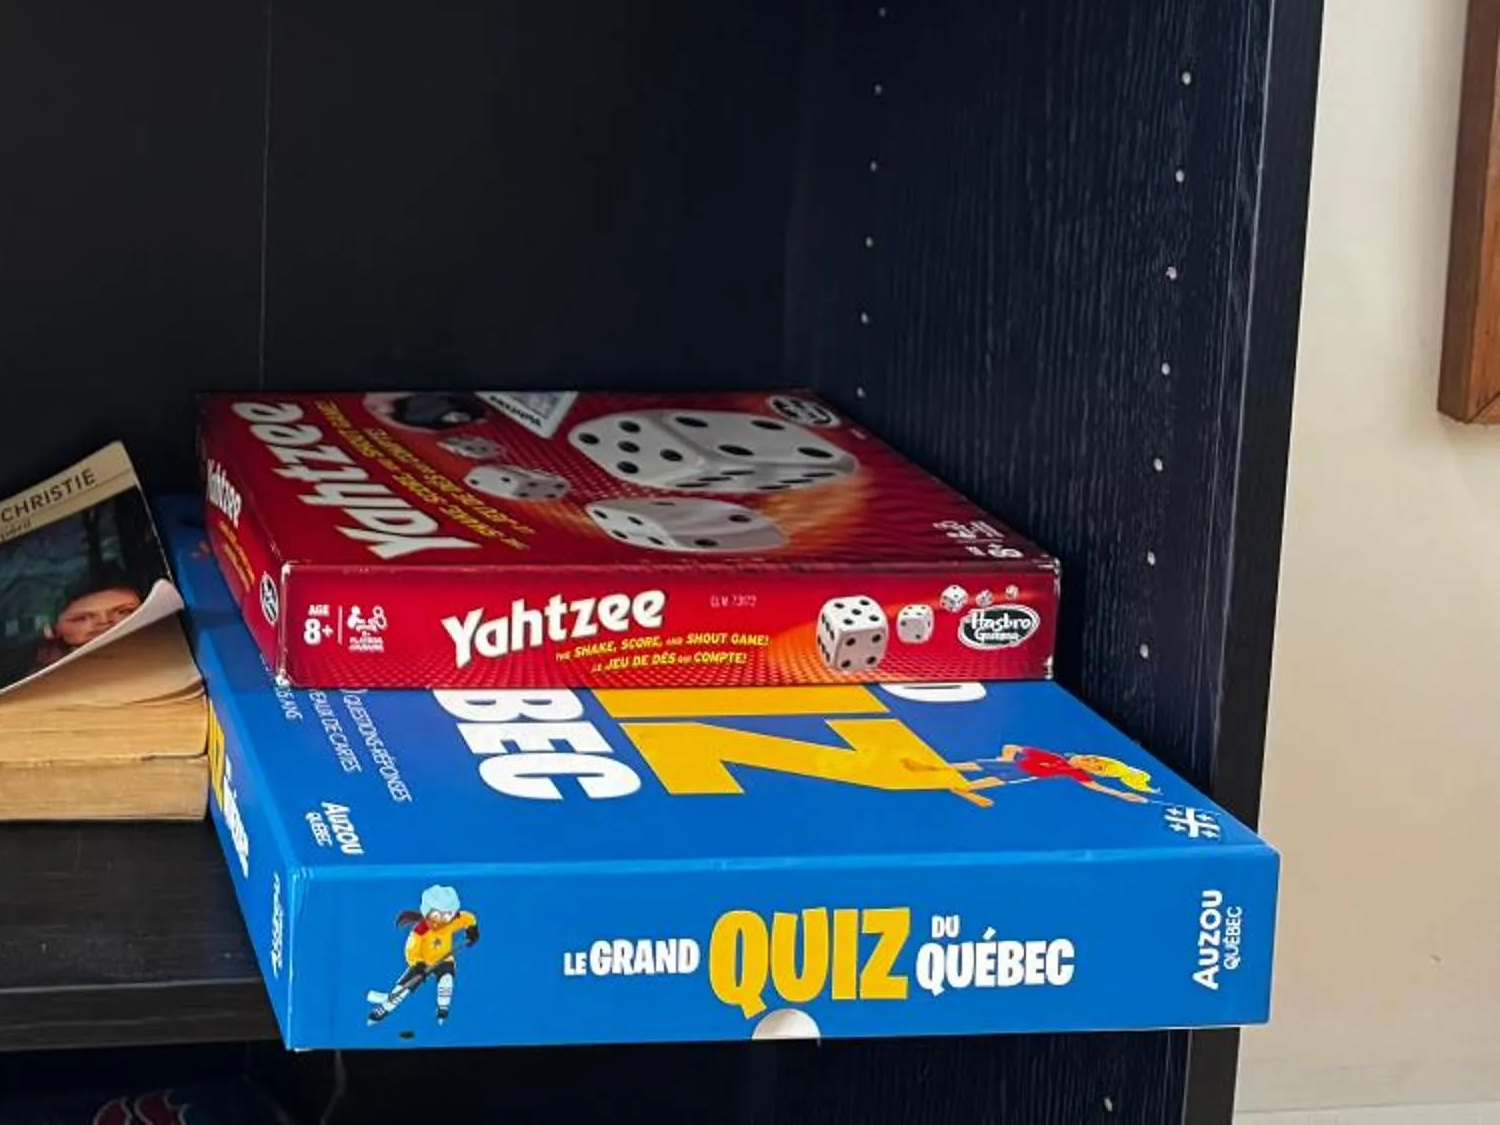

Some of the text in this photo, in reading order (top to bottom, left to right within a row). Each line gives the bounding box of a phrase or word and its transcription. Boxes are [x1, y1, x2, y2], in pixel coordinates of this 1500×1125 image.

[0, 468, 99, 525] CHRISTIE
[230, 401, 485, 561] Yahtzee
[303, 617, 335, 646] 8+
[307, 604, 331, 617] AGE
[441, 589, 667, 669] Yahtzee
[970, 610, 1035, 635] Hasbro
[573, 640, 618, 659] SHAKE,
[620, 635, 664, 651] SCORE,
[685, 632, 728, 646] SHOUT
[731, 632, 771, 647] GAME!
[605, 655, 630, 672] JEU
[631, 654, 650, 668] DE
[651, 651, 677, 666] DÉS
[693, 651, 748, 666] COMPTE!
[320, 800, 365, 856] AUZOU
[563, 905, 1076, 1021] LE GRAND QUIZ DU QUÉBEC
[1192, 888, 1224, 992] AUZOU
[1222, 904, 1244, 972] QUÉBEC
